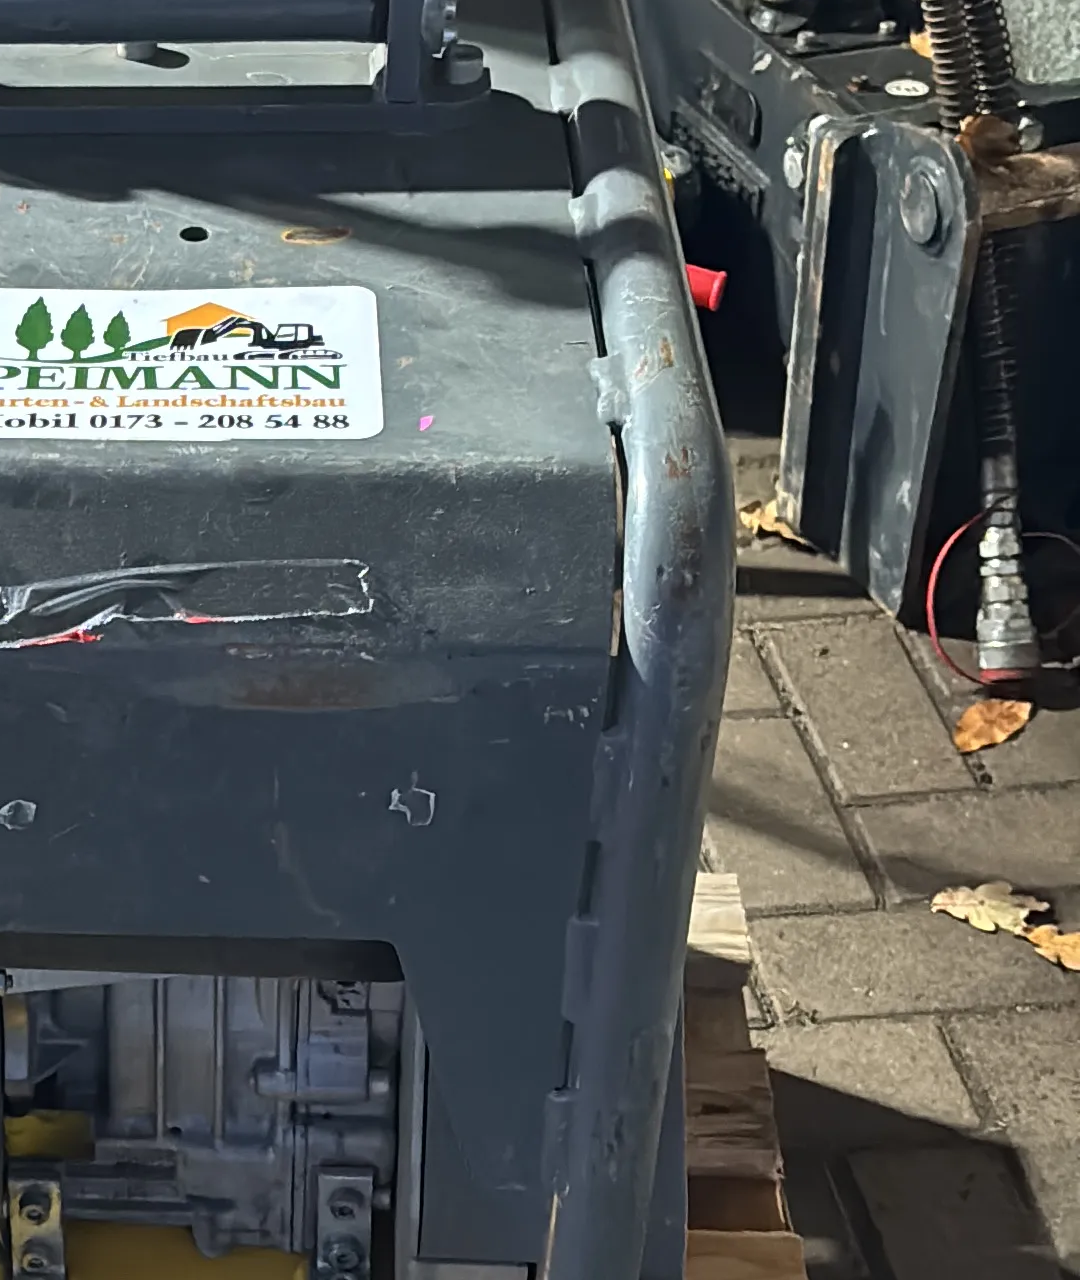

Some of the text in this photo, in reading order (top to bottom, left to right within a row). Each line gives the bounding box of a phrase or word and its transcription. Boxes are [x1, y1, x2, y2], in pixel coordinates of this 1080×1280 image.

[126, 351, 228, 362] Tiefbau
[89, 395, 109, 408] &
[116, 393, 348, 408] Landschaftsbau
[89, 413, 163, 430] 0173
[197, 412, 254, 429] 208
[263, 412, 302, 429] 54
[312, 412, 350, 429] 88
